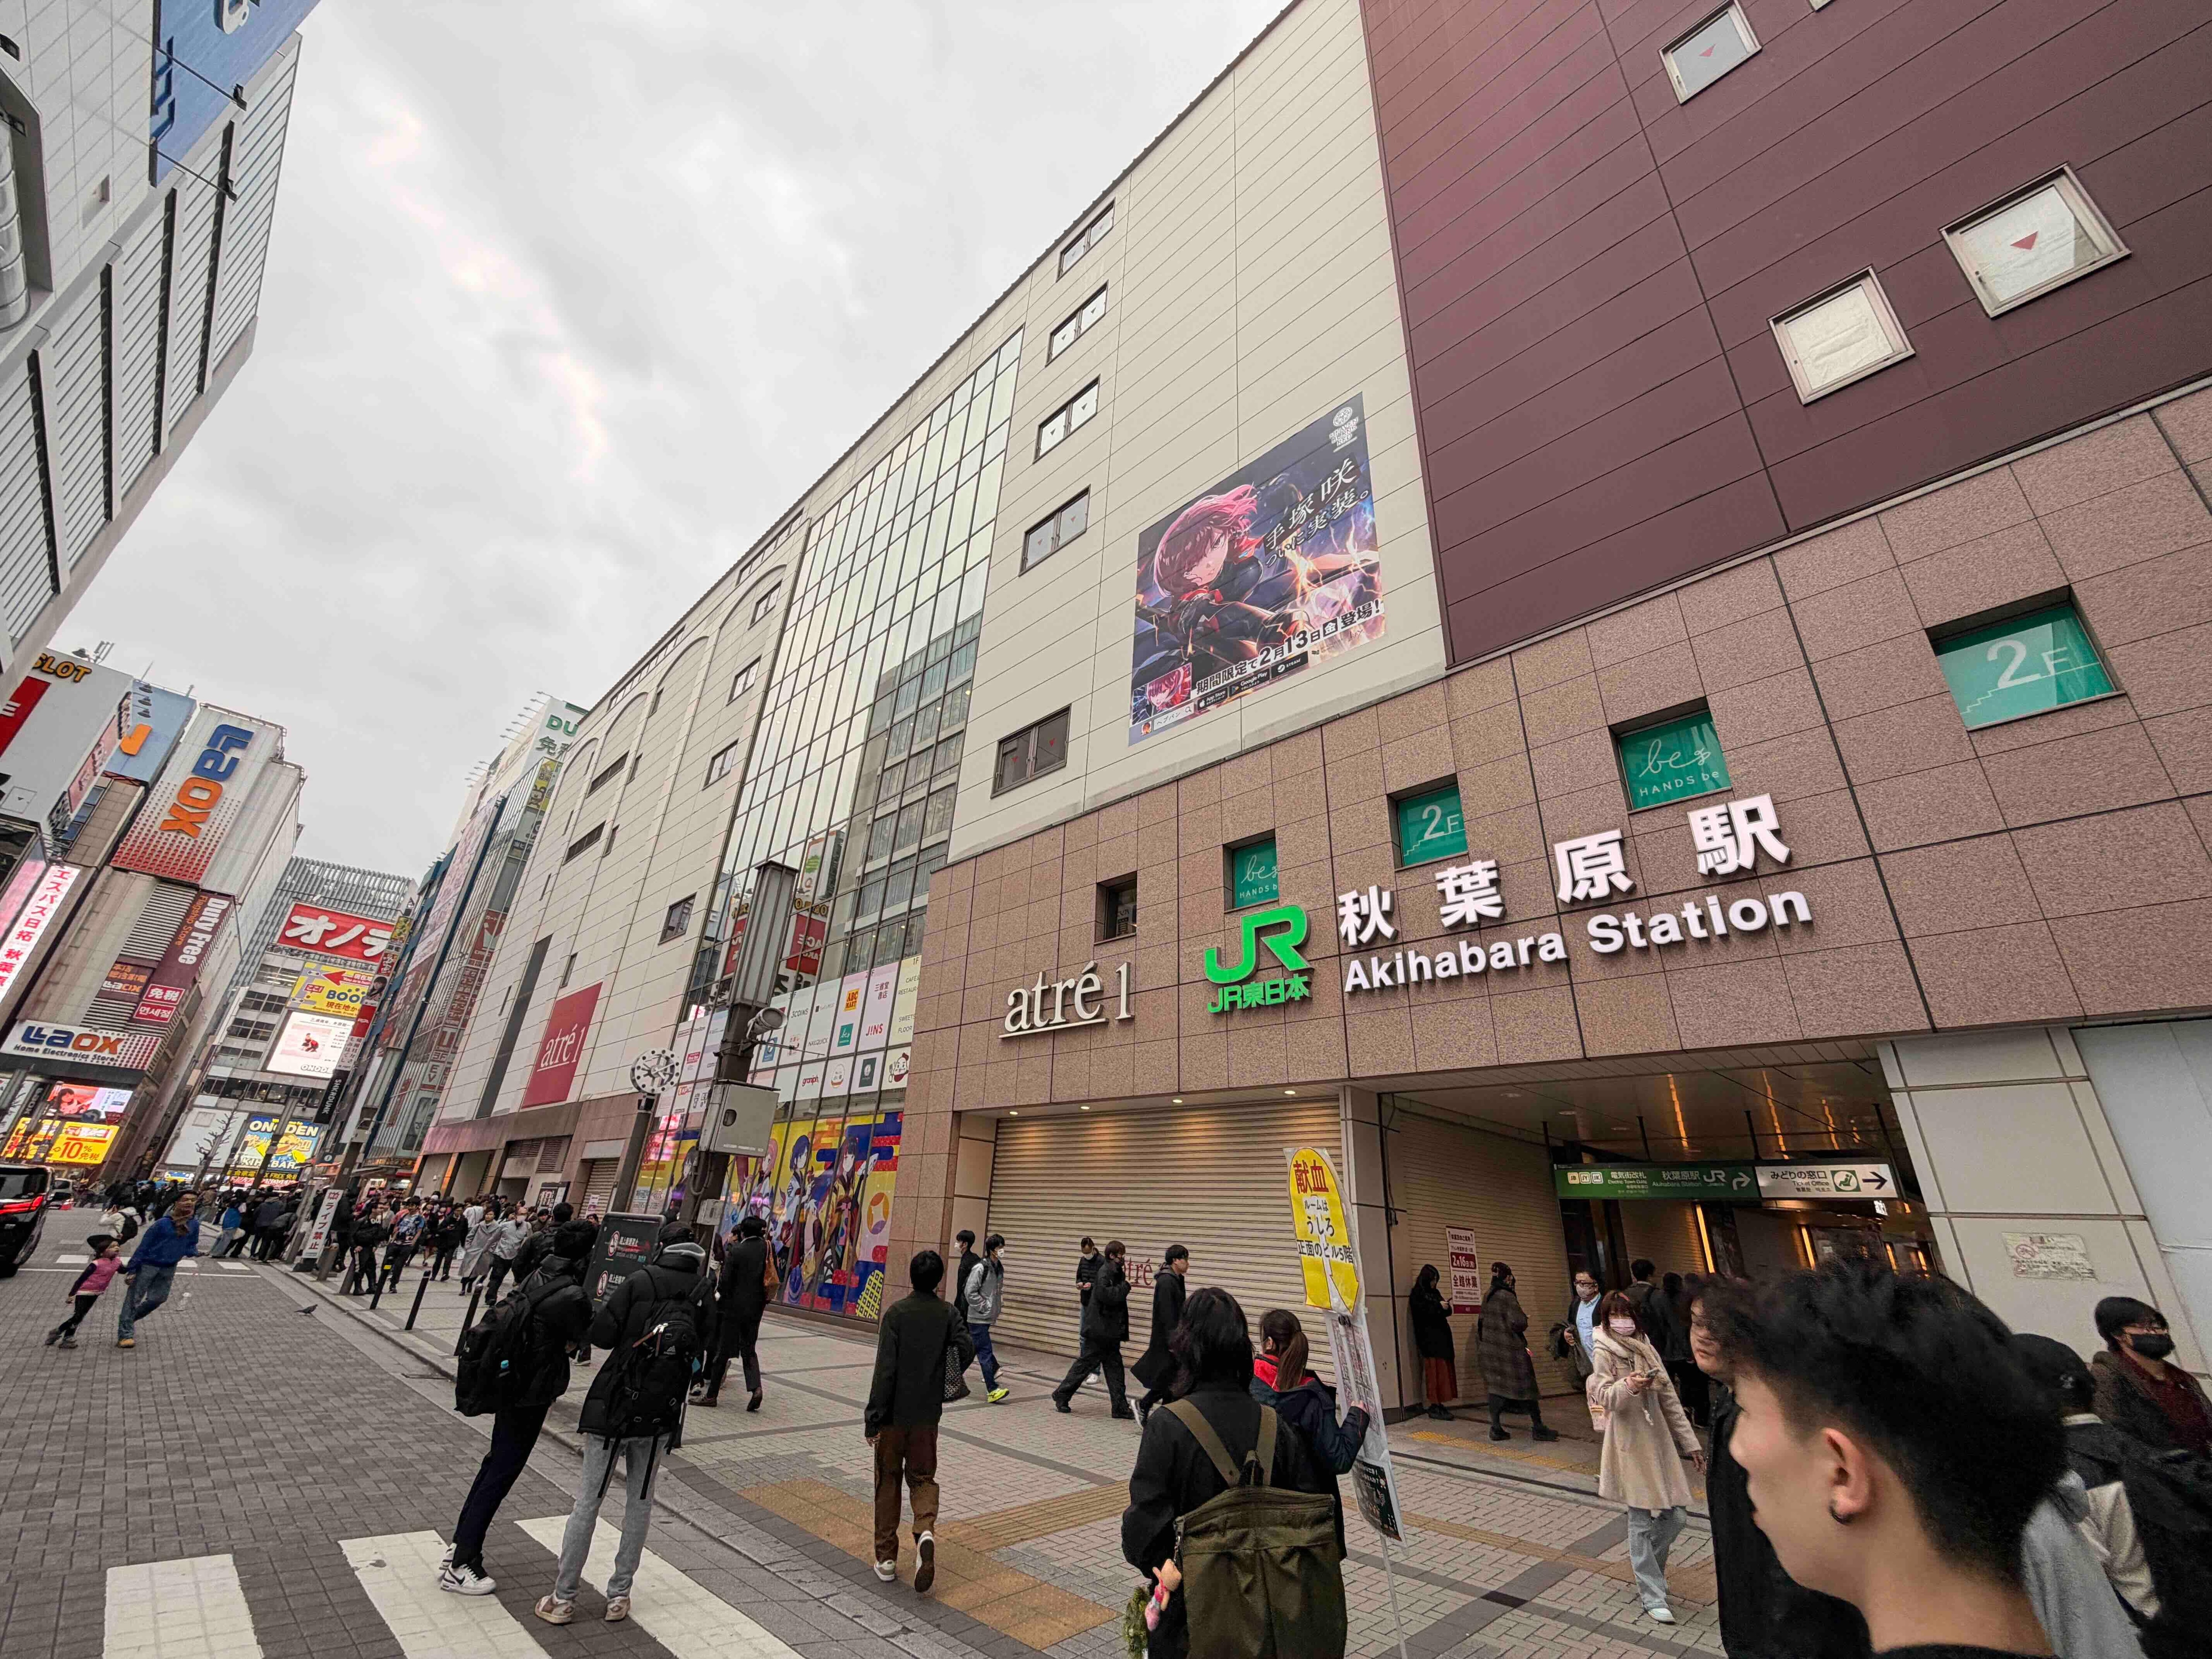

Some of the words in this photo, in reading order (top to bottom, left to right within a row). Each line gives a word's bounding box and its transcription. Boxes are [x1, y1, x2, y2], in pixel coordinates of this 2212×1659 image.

[1286, 658, 1301, 668] STEAM
[1240, 676, 1256, 687] Google
[1257, 671, 1267, 680] Play
[1206, 695, 1214, 703] App
[1215, 690, 1226, 699] Store
[1640, 775, 1695, 797] HANDS
[1701, 770, 1720, 782] be
[1338, 792, 1792, 948] 秋葉原駅
[1239, 885, 1269, 899] HANDS
[15, 869, 71, 942] エスパス日拓
[186, 895, 208, 924] Flagship
[194, 897, 230, 932] Duty
[175, 925, 192, 946] Store
[1204, 904, 1312, 984] JR
[1345, 931, 1569, 993] Akihabara
[1586, 890, 1813, 954] Station
[178, 931, 213, 964] Free
[147, 987, 180, 1001] 免税
[847, 991, 858, 1002] ABC
[898, 986, 918, 995] RESTAUR
[1206, 973, 1312, 1013] JR東日本
[139, 1006, 173, 1018] 면세점
[326, 1002, 361, 1012] 現在地か
[791, 1008, 809, 1018] 3COINS
[13, 1044, 40, 1053] Home
[42, 1048, 90, 1060] Electronics
[322, 1079, 342, 1114] SNKRDUNK
[1293, 1159, 1329, 1194] 献血
[1703, 1170, 1727, 1183] JR
[1770, 1171, 1828, 1179] みどりの窓口
[1304, 1199, 1329, 1212] ルームは
[1307, 1217, 1335, 1237] うしろ
[1124, 1257, 1153, 1286] tré
